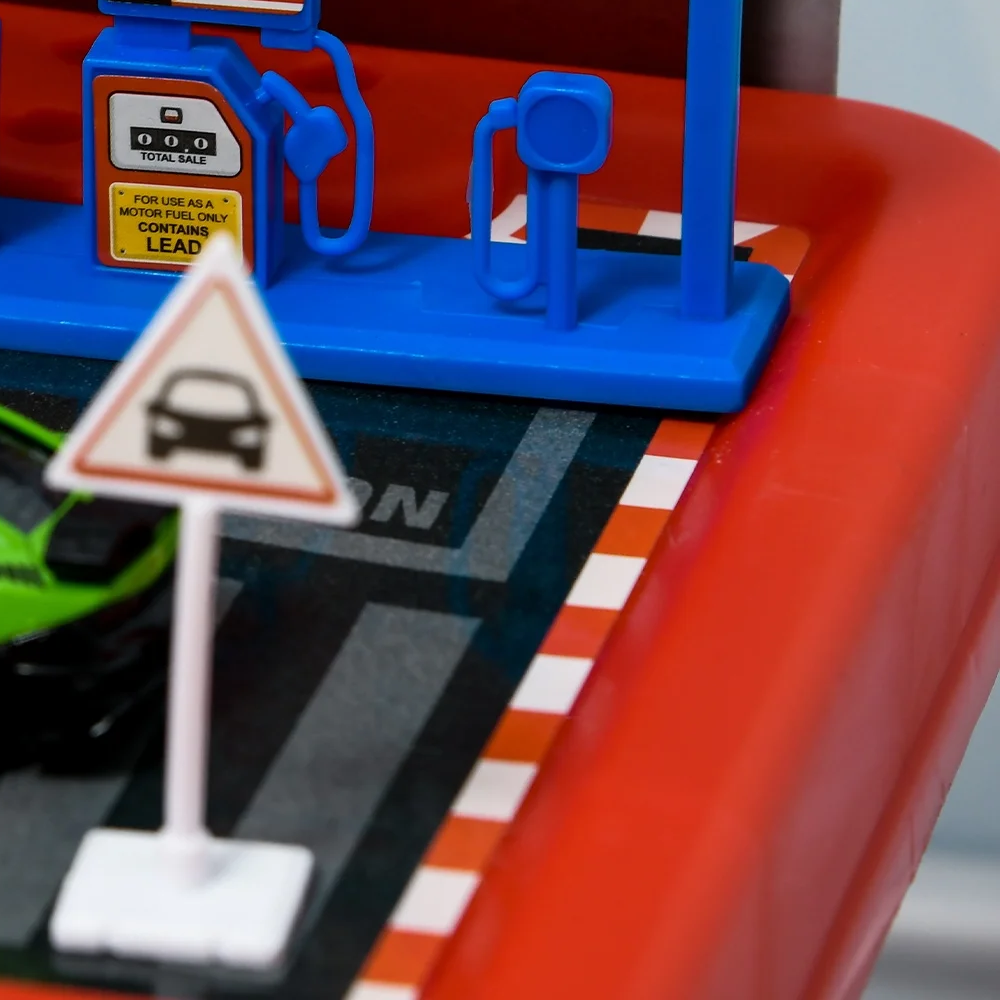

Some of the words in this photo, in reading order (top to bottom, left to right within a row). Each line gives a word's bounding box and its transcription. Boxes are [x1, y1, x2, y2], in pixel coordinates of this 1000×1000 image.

[140, 151, 176, 163] TOTAL
[178, 154, 207, 165] SALE
[134, 194, 158, 205] FOR
[161, 196, 185, 207] USE
[188, 198, 203, 208] AS
[205, 200, 214, 209] A
[119, 207, 162, 219] MOTOR
[165, 210, 194, 221] FUEL
[198, 212, 228, 223] ONLY
[138, 221, 209, 237] CONTAINS
[147, 236, 202, 255] LEAD
